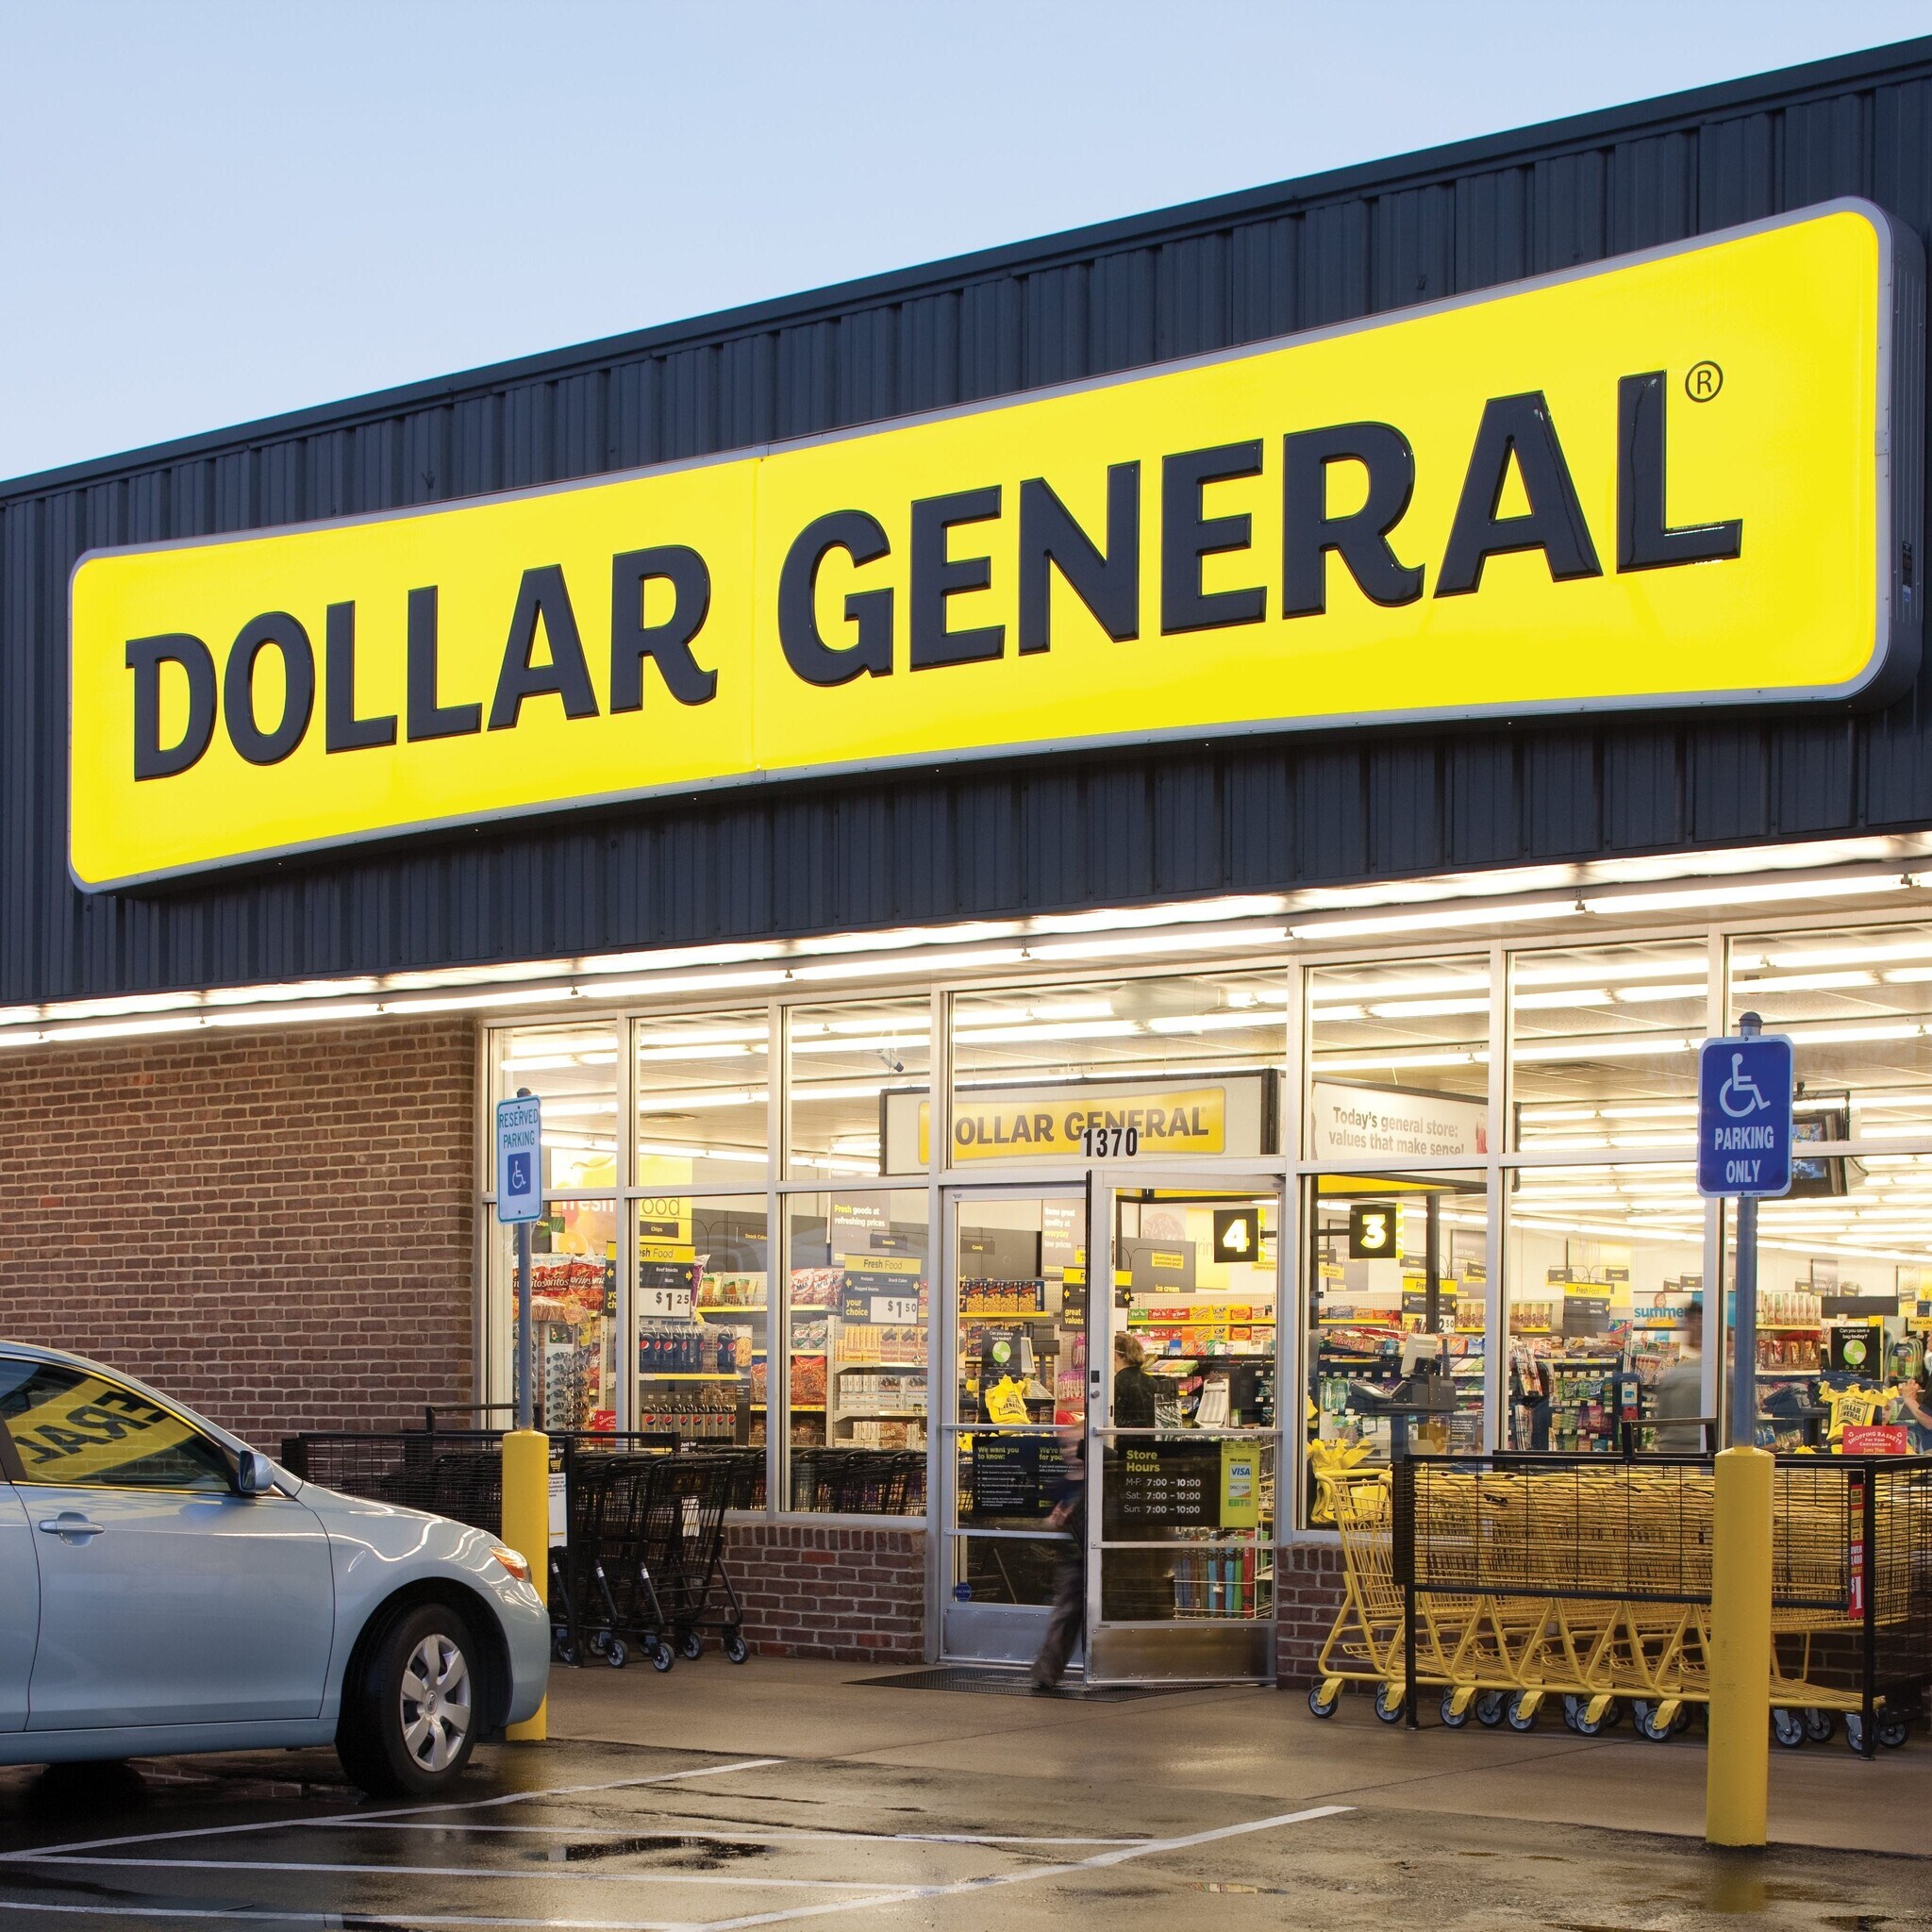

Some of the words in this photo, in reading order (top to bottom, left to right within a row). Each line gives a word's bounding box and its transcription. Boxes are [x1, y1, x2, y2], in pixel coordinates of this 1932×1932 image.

[125, 544, 719, 782] DOLLAR
[776, 368, 1743, 689] GENERAL
[499, 1108, 539, 1129] RESERVED
[1333, 1107, 1377, 1130] Today's
[1381, 1116, 1424, 1134] general
[1426, 1120, 1458, 1138] store:
[955, 1114, 1055, 1146] OLLAR
[1064, 1106, 1209, 1140] GENERAL
[503, 1130, 535, 1149] PARKING
[1083, 1127, 1138, 1158] 1370
[1328, 1129, 1367, 1149] values
[1370, 1133, 1394, 1152] that
[1397, 1138, 1427, 1156] make
[1714, 1125, 1774, 1150] PARKING
[1725, 1159, 1761, 1184] ONLY
[642, 1197, 679, 1216] ood
[834, 1204, 852, 1214] Fresh
[853, 1206, 873, 1216] goods
[874, 1207, 880, 1215] at
[1061, 1208, 1075, 1218] great
[834, 1217, 866, 1227] refreshing
[866, 1218, 886, 1227] prices
[1044, 1218, 1064, 1228] quality
[1223, 1219, 1251, 1253] 4
[1359, 1213, 1387, 1249] 3
[653, 1248, 675, 1258] Food
[863, 1258, 883, 1269] Fresh
[885, 1260, 903, 1270] Food
[1155, 1284, 1163, 1292] ice
[1575, 1286, 1589, 1294] Fresh
[608, 1291, 616, 1301] yo
[846, 1299, 862, 1308] your
[845, 1307, 869, 1316] choice
[1064, 1308, 1081, 1317] great
[1064, 1317, 1084, 1325] values
[1848, 1431, 1876, 1445] SHOPPING
[1877, 1431, 1903, 1445] BASKETS
[1125, 1449, 1158, 1460] Store
[1125, 1462, 1160, 1473] Hours
[1231, 1467, 1251, 1476] VISA
[1125, 1477, 1142, 1487] M-F:
[1146, 1478, 1168, 1487] 7:00
[1176, 1478, 1201, 1487] 10:00
[1125, 1491, 1141, 1500] Sat:
[1146, 1491, 1168, 1500] 7:00
[1176, 1491, 1201, 1500] 10:00
[1228, 1498, 1244, 1507] EBT
[1124, 1504, 1141, 1513] Sun:
[1145, 1505, 1167, 1514] 7:00
[1176, 1505, 1201, 1514] 10:00
